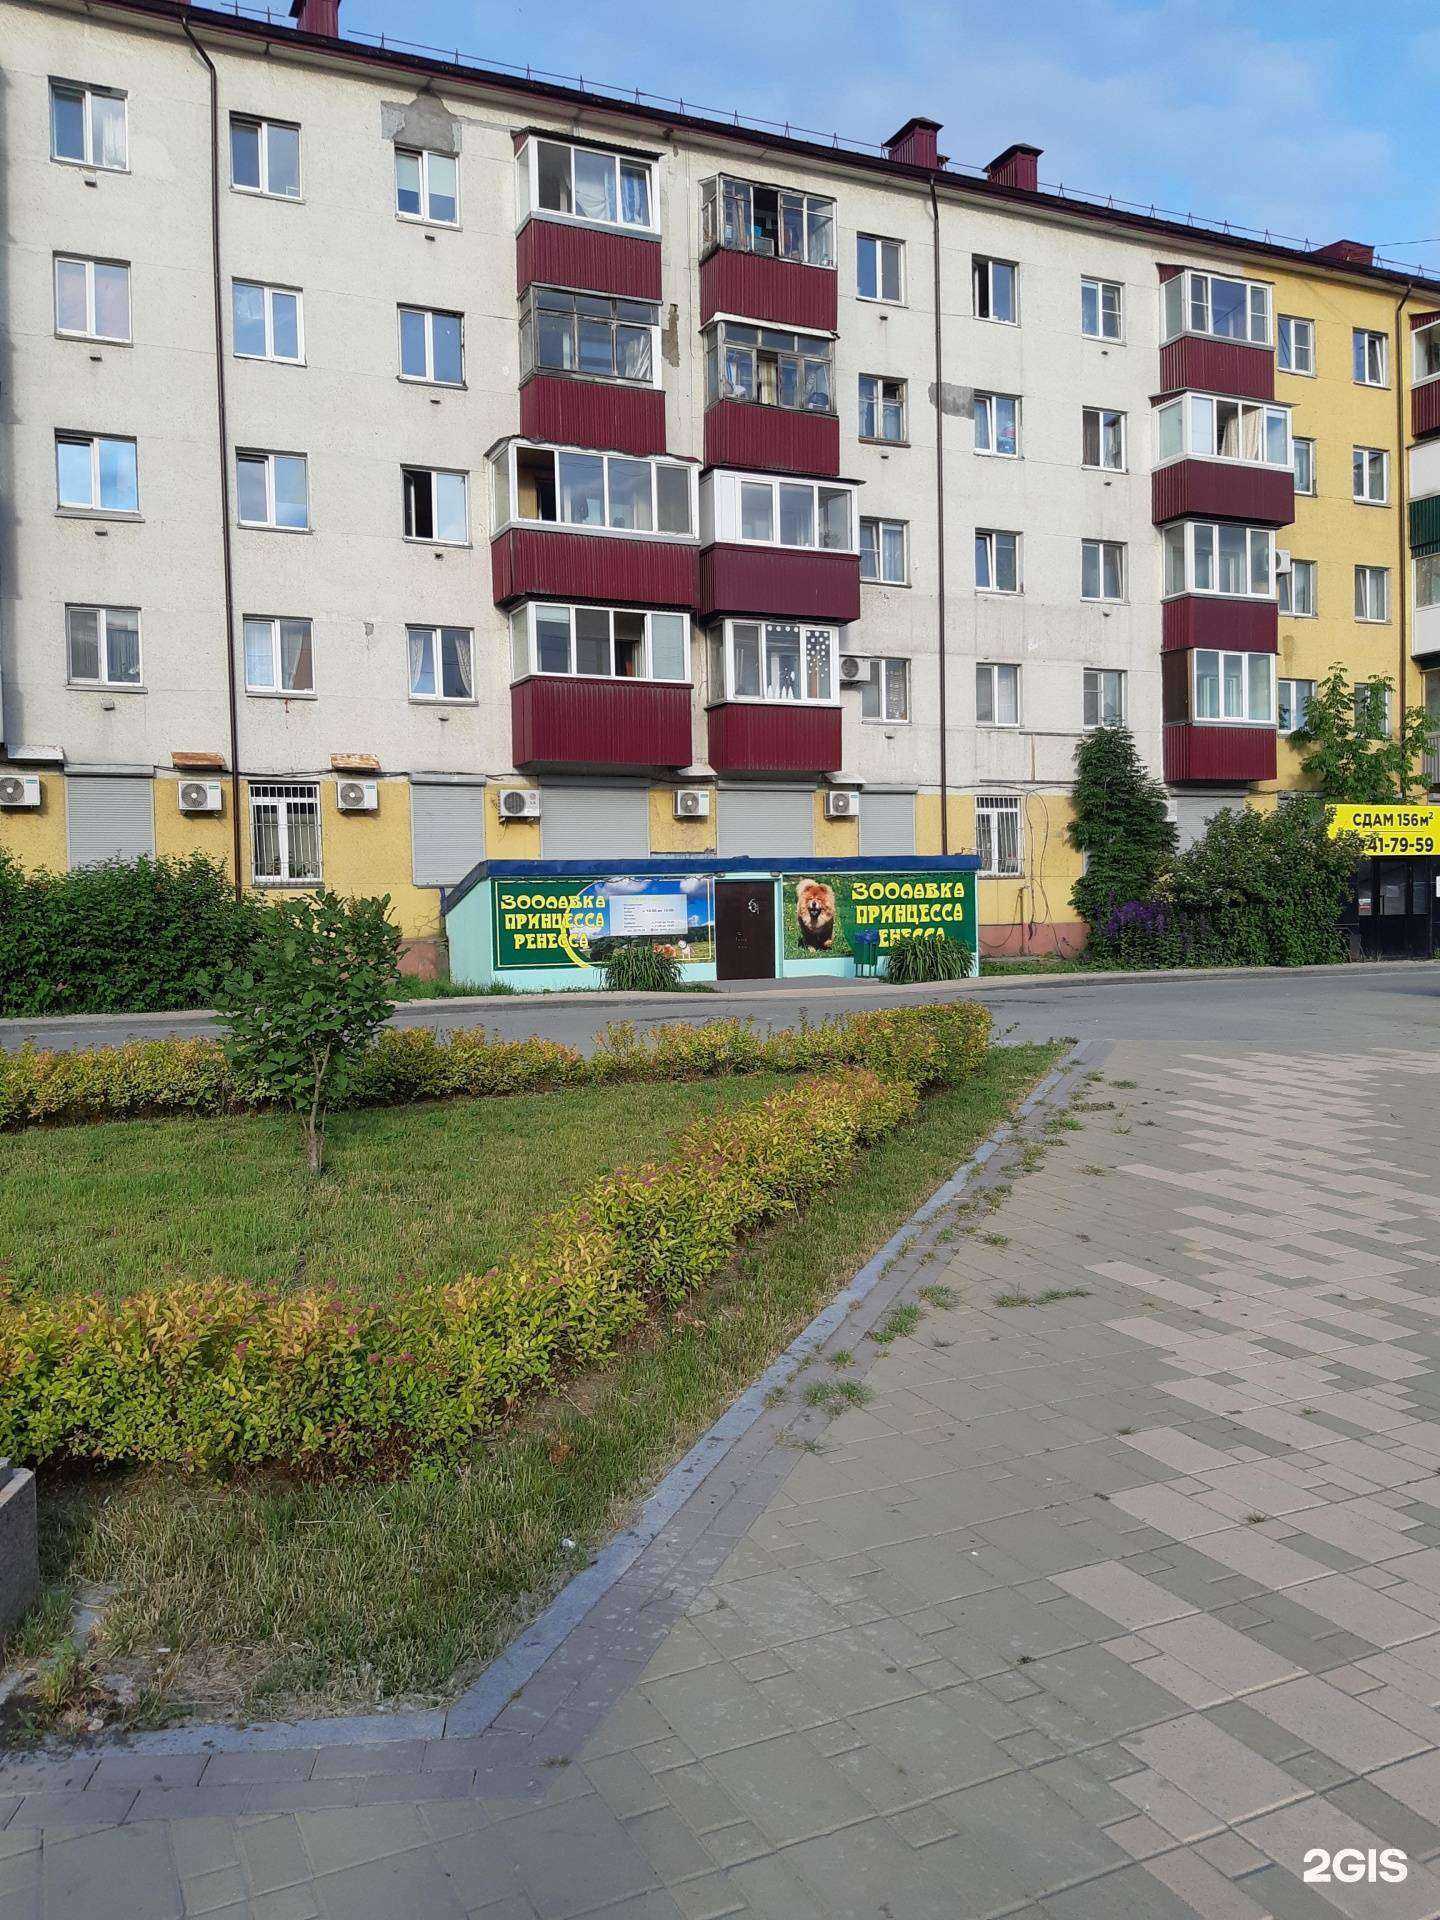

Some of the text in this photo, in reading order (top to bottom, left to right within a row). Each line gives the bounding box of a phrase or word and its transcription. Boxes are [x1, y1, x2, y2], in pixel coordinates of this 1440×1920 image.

[1352, 813, 1394, 828] СДАМ
[1360, 837, 1434, 852] 41-79-59
[851, 882, 965, 900] ЗООЛАВКА
[500, 894, 606, 910] ЗООЛАВКА
[504, 912, 604, 930] ПРИНЦЕССА
[855, 903, 963, 924] ПРИНЦЕССА
[513, 932, 589, 950] РЕНЕССА
